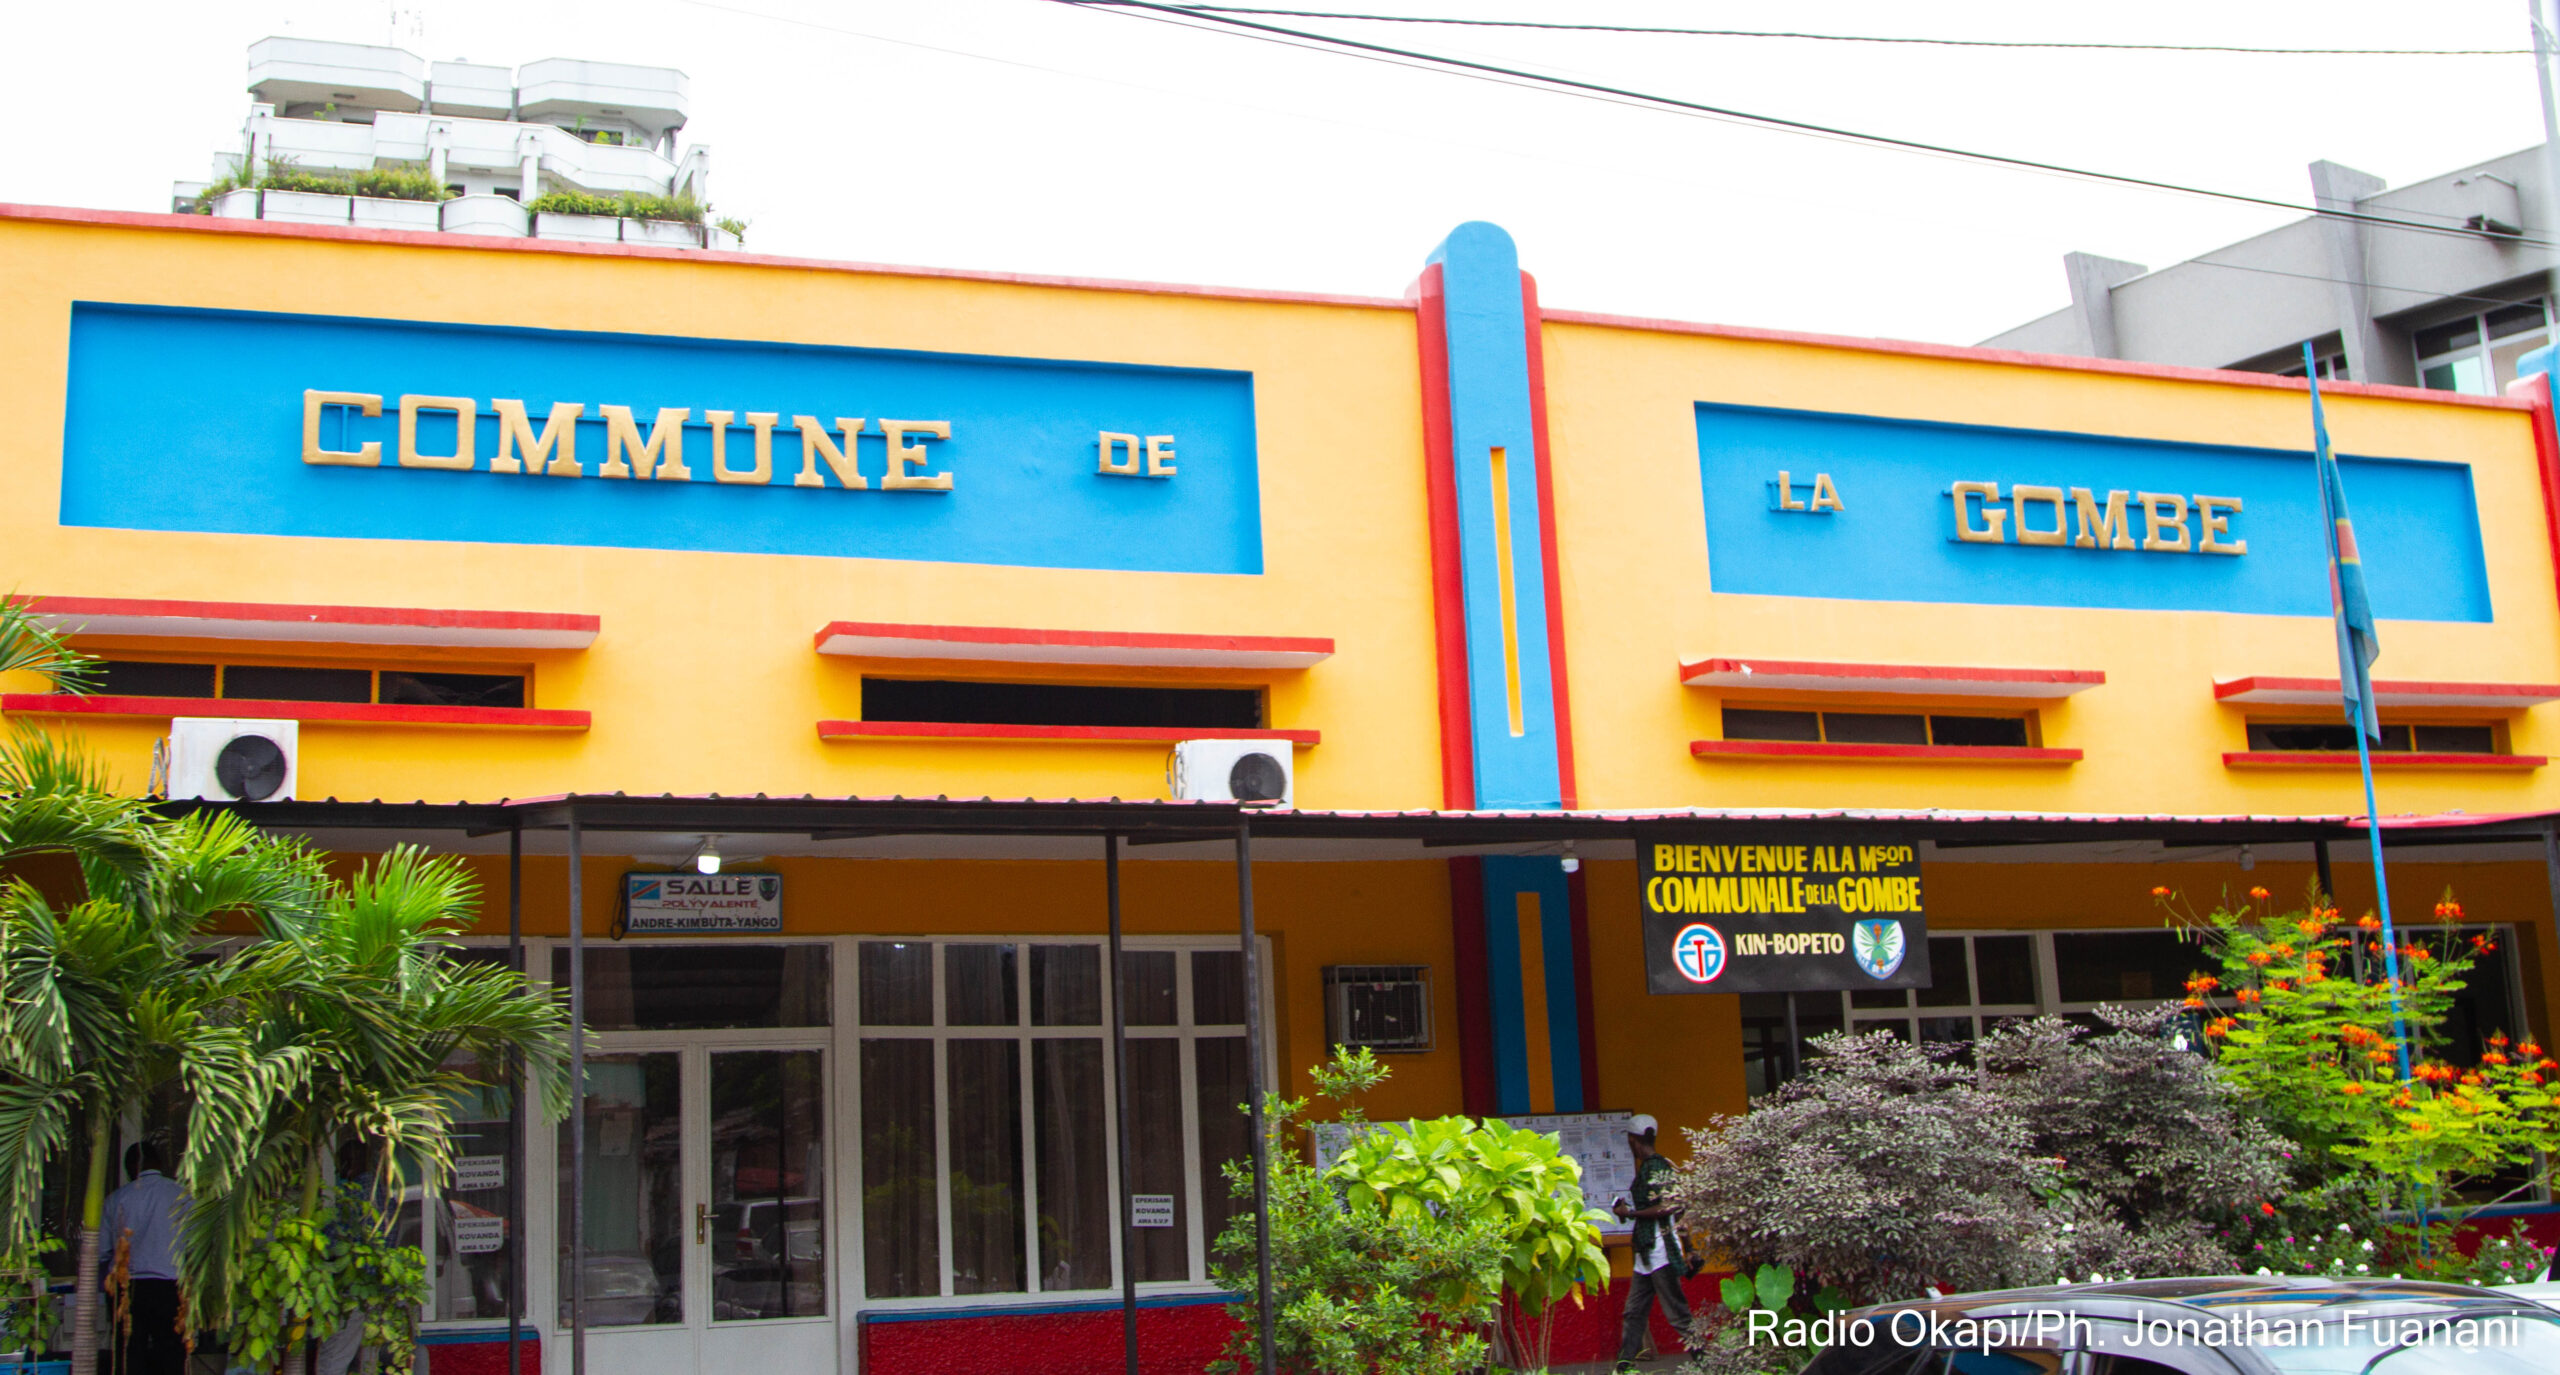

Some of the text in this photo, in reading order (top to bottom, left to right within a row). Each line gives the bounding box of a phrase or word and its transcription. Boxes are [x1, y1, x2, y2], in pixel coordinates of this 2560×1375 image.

[302, 388, 1177, 491] COMMUNE DE
[1778, 470, 2247, 555] LA GOMBE
[1654, 844, 1807, 872] BIENVENUE
[667, 879, 752, 895] SALLE
[1647, 876, 1806, 913] COMMUNALE
[1837, 876, 1922, 912] GOMBE
[631, 917, 778, 929] ANDRE-KIMBUTA-YANGO
[1735, 933, 1845, 955] KIN-BOPETO
